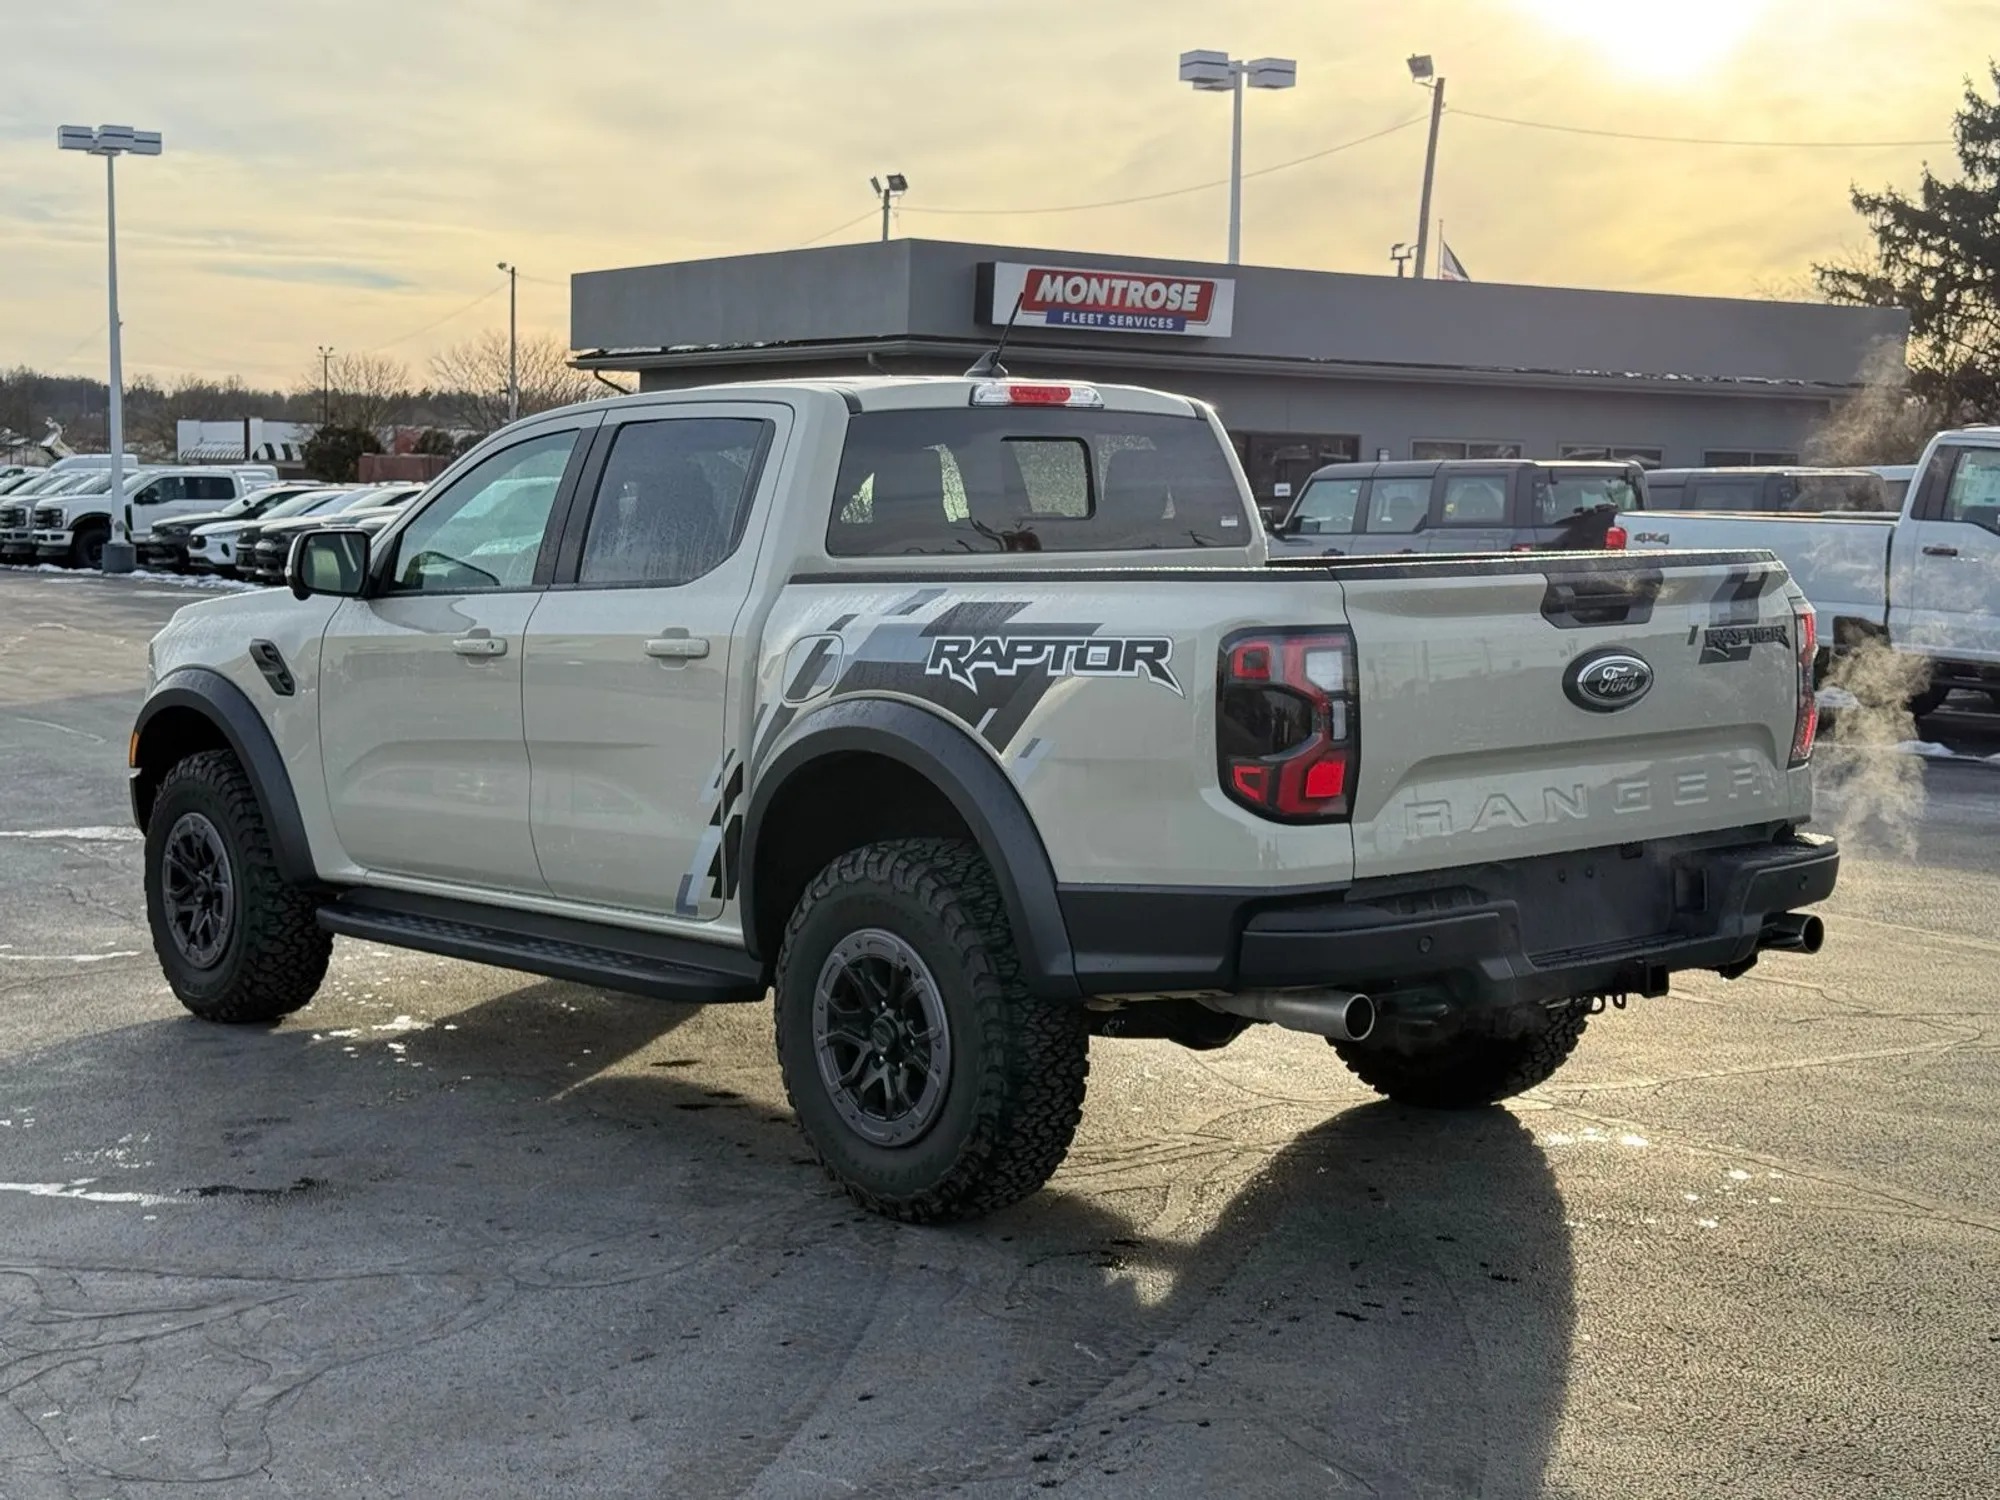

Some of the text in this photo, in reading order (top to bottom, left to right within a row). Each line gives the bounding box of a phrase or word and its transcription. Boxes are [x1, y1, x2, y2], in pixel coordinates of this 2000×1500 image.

[1035, 274, 1201, 312] MONTROSE
[1062, 311, 1175, 330] FLEET SERVICES
[1703, 625, 1791, 657] RAPTOR
[924, 635, 1187, 701] RAPTOR
[1598, 666, 1639, 694] Ford
[1404, 761, 1763, 841] RANGER
